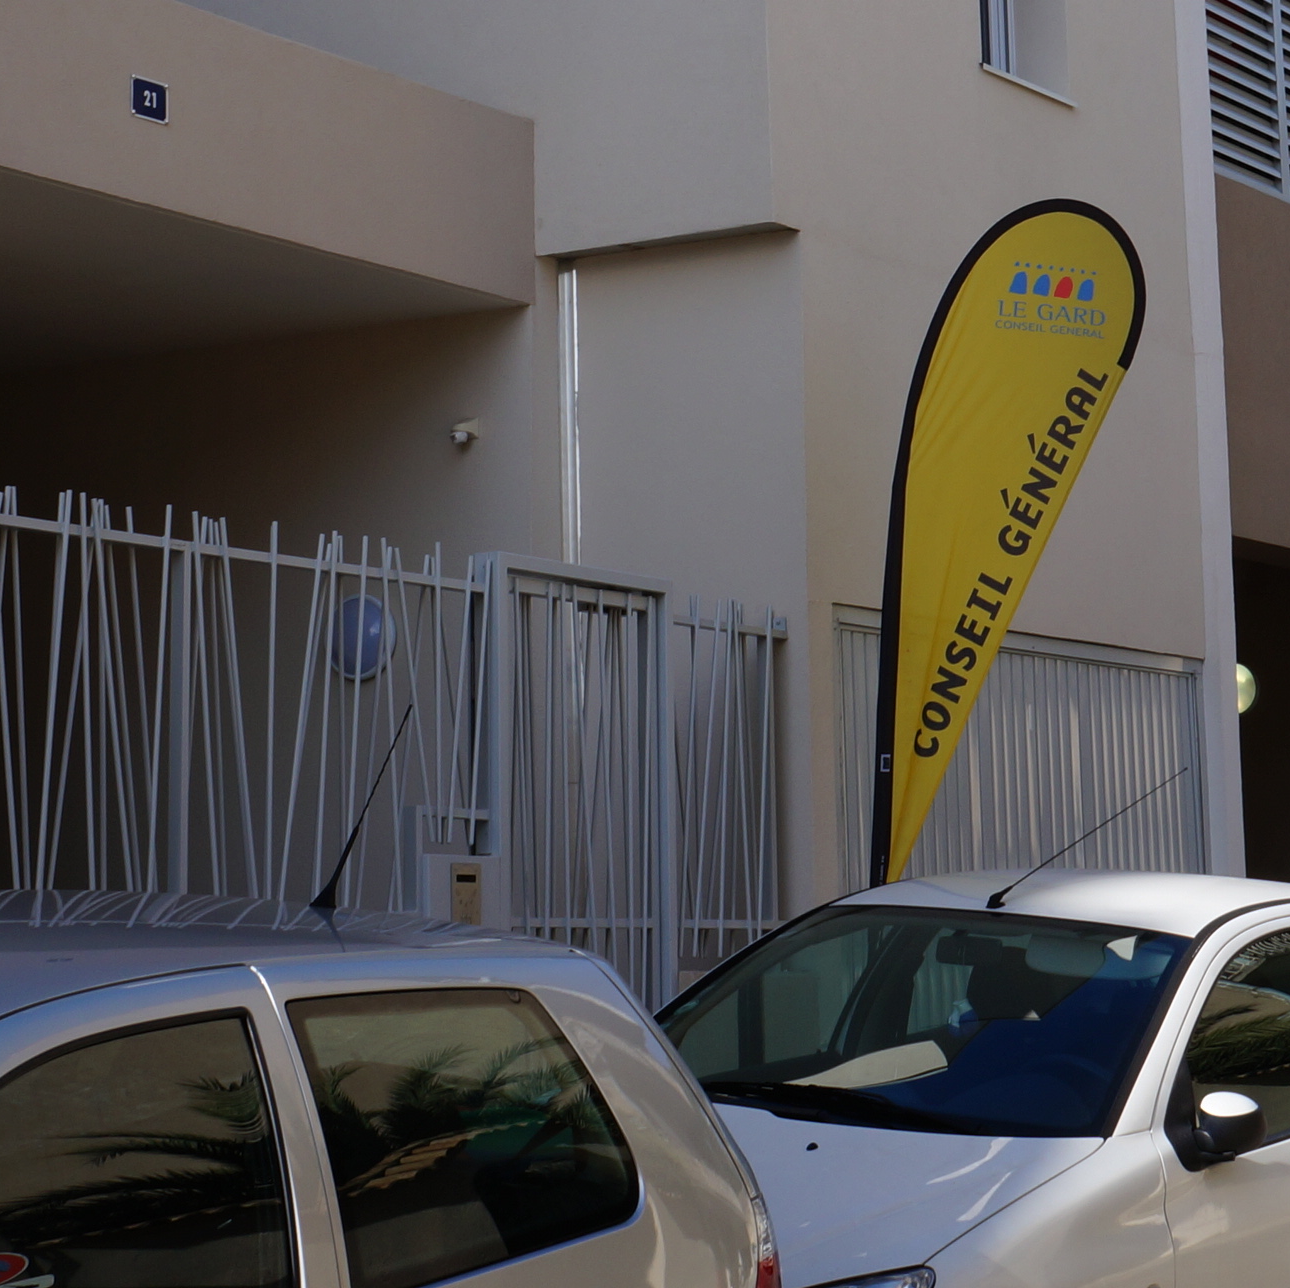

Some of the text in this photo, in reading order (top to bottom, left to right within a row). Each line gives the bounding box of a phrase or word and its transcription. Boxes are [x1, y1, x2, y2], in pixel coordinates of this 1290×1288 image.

[143, 89, 157, 109] 21
[997, 299, 1107, 327] LE GARD
[994, 319, 1046, 333] CONSEIL
[913, 367, 1109, 759] CONSEIL GÉNÉRAL
